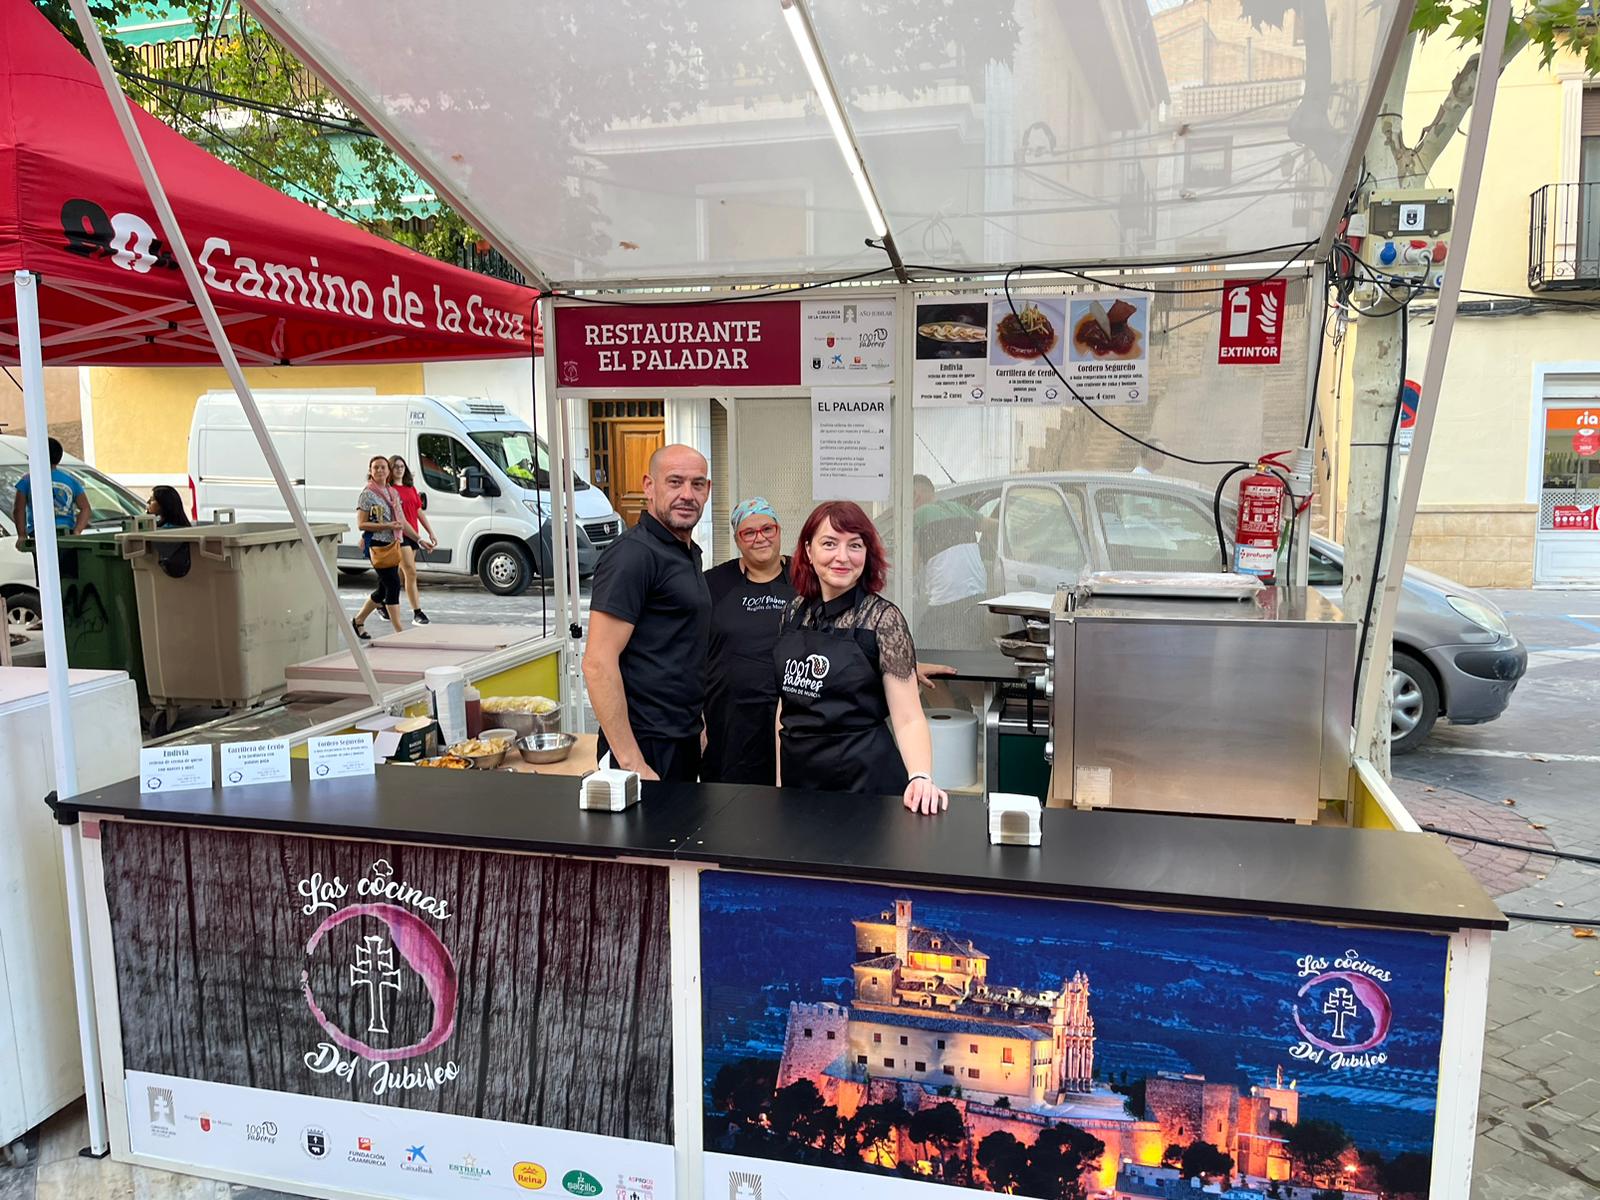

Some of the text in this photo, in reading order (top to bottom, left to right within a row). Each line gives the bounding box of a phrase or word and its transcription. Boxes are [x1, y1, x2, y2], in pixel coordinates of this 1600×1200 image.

[199, 237, 374, 319] Camino
[382, 275, 425, 328] de
[433, 284, 464, 333] la
[467, 295, 525, 340] Cruz
[585, 321, 761, 345] RESTAURANTE
[1220, 346, 1278, 357] EXTINTOR
[598, 348, 749, 372] EL PALADAR
[996, 369, 1026, 377] Carrillera
[1037, 368, 1056, 377] Cerdo
[1078, 363, 1136, 372] Cordero Segureño
[818, 402, 885, 412] EL PALADAR
[1576, 410, 1599, 425] ria
[298, 872, 452, 920] Las cocinas
[1296, 955, 1392, 982] Las cocinas
[1289, 1041, 1388, 1070] Del Jubileo
[304, 1043, 460, 1096] Del Jubileo
[349, 1150, 385, 1160] FUNDACIÓN
[347, 1156, 387, 1167] CAJAMURCIA
[400, 1162, 433, 1174] CaixaBank
[449, 1164, 491, 1176] ESTRELLA
[518, 1174, 542, 1185] Reina
